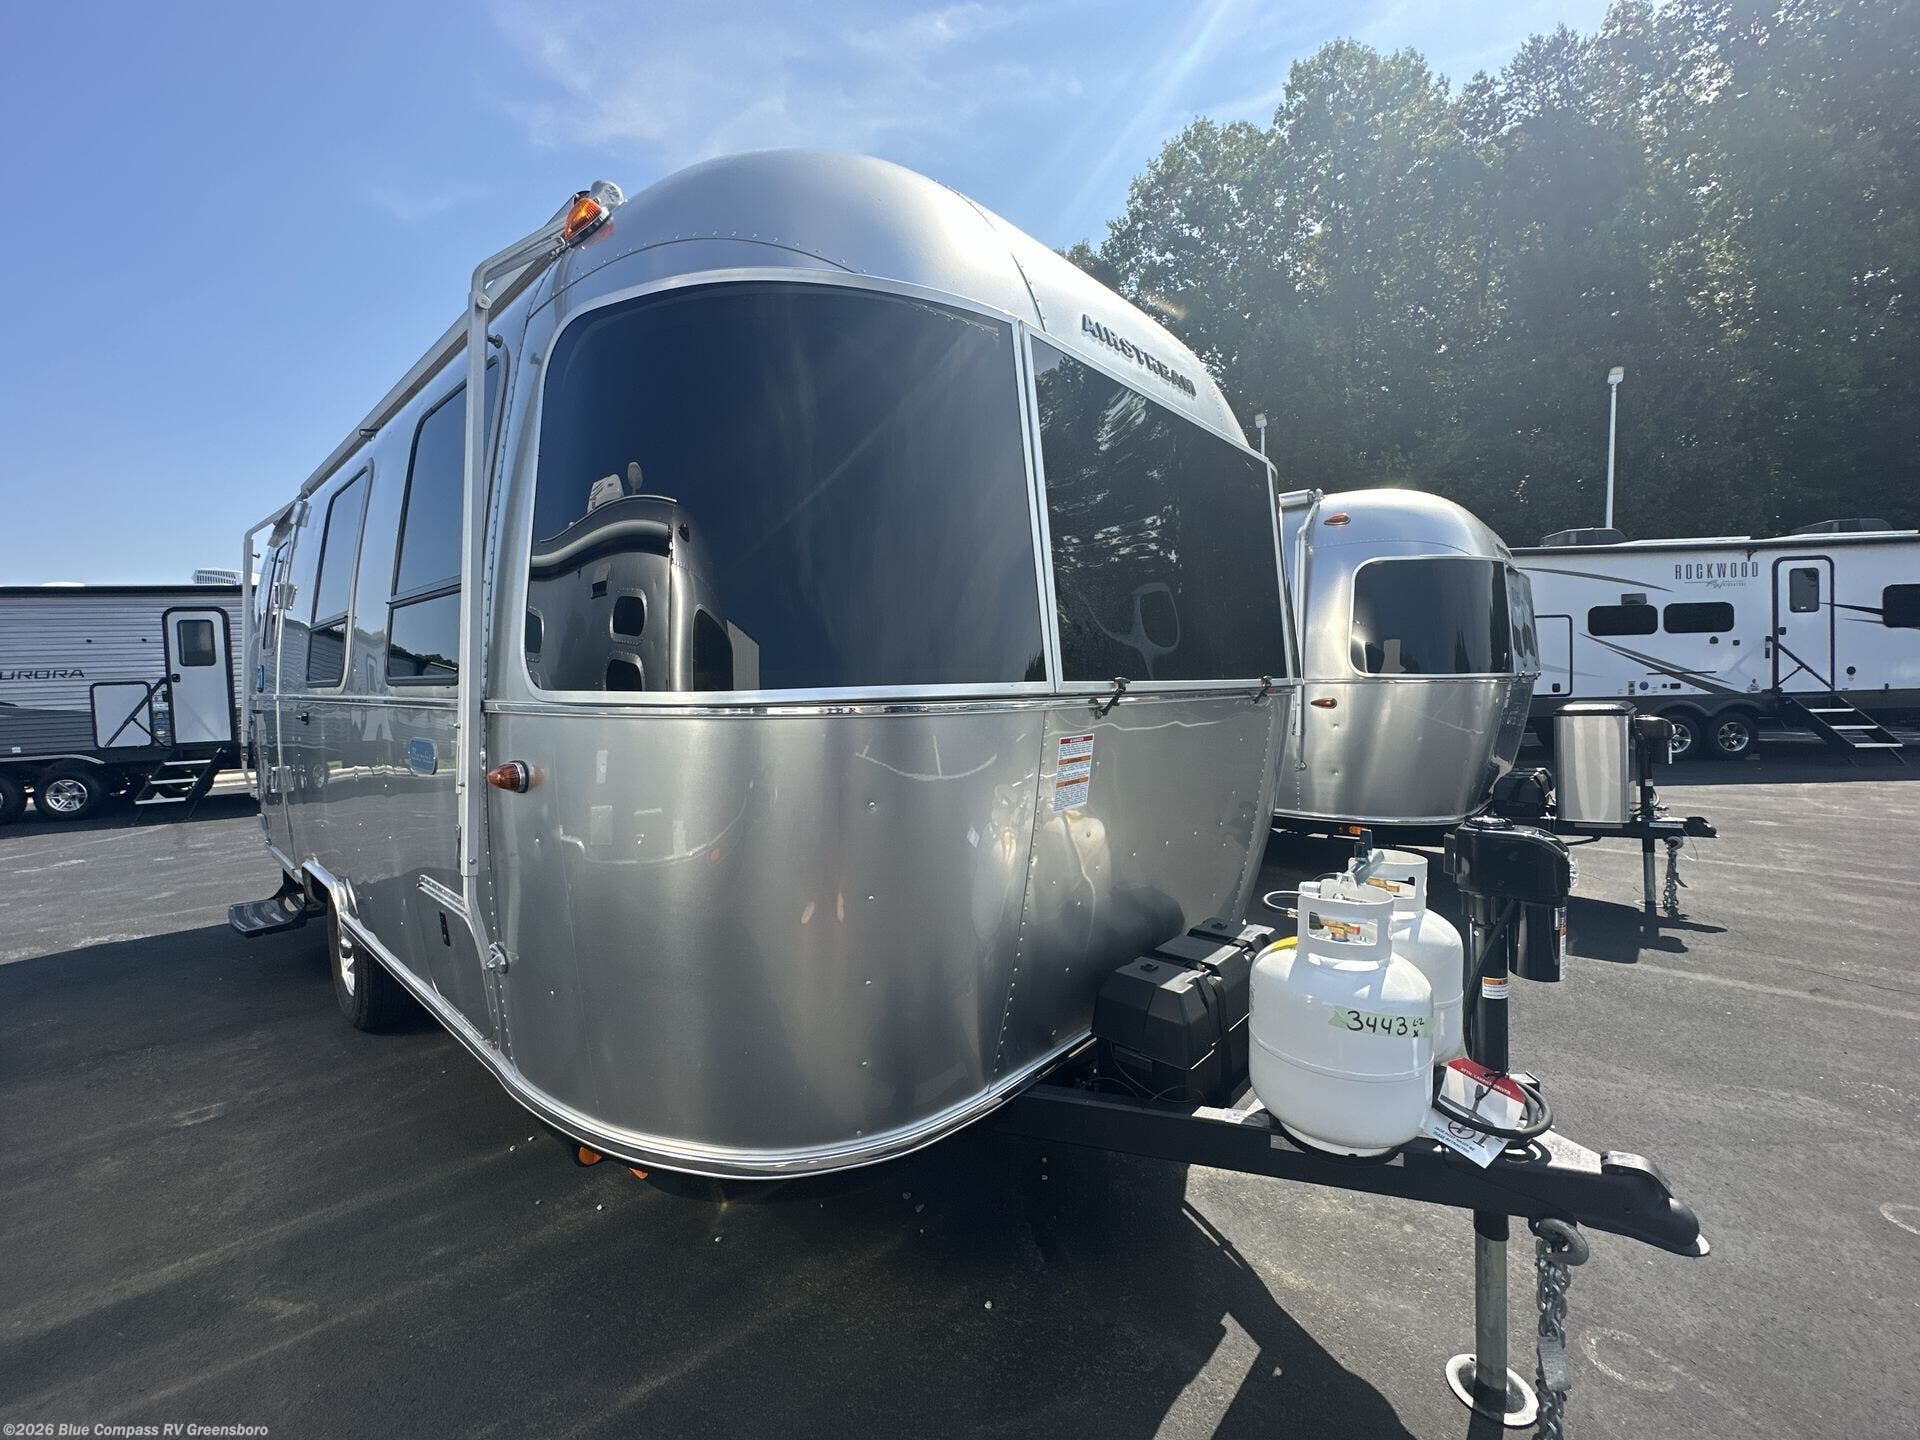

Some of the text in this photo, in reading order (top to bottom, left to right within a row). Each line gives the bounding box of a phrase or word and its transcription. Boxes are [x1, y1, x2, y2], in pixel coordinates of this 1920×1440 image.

[1081, 313, 1198, 398] AIRSTREAM
[1675, 562, 1759, 580] ROCKWOOD
[1346, 1010, 1408, 1036] 3443
